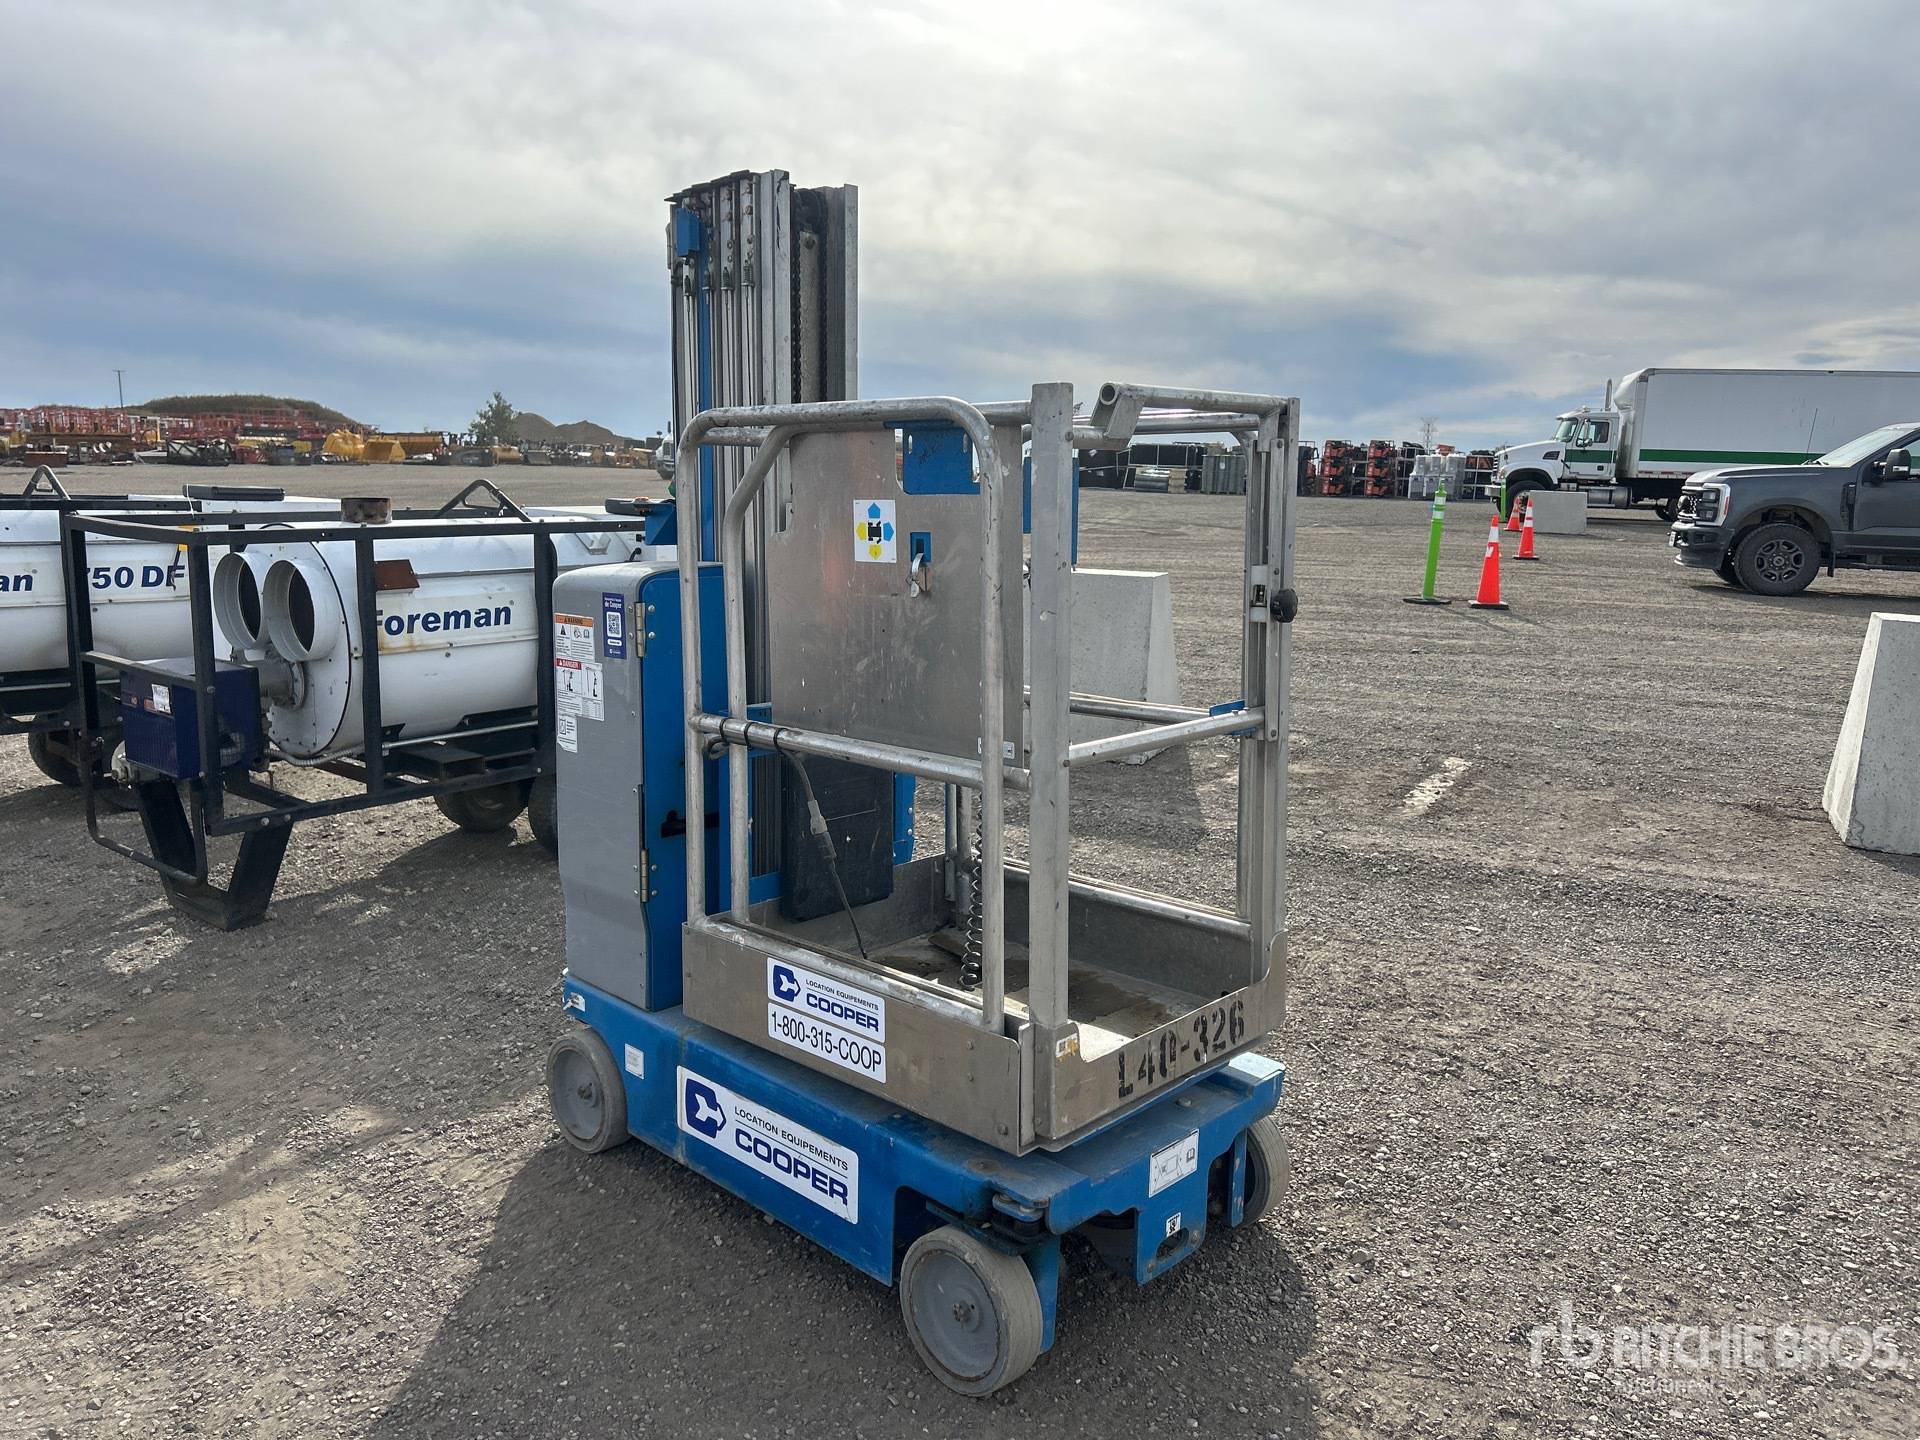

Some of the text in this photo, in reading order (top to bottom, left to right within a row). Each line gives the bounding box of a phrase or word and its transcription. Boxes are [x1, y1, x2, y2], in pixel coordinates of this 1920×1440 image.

[87, 566, 135, 589] 50
[562, 660, 579, 669] DANGER
[806, 979, 879, 1011] LOCATION EQUIPEMENTS
[806, 992, 879, 1033] COOPER
[771, 1011, 882, 1072] 1-800-315-COOP
[1118, 1000, 1245, 1099] L40-326
[734, 1106, 849, 1172] LOCATION EQUIPEMENTS
[734, 1128, 849, 1207] COOPER
